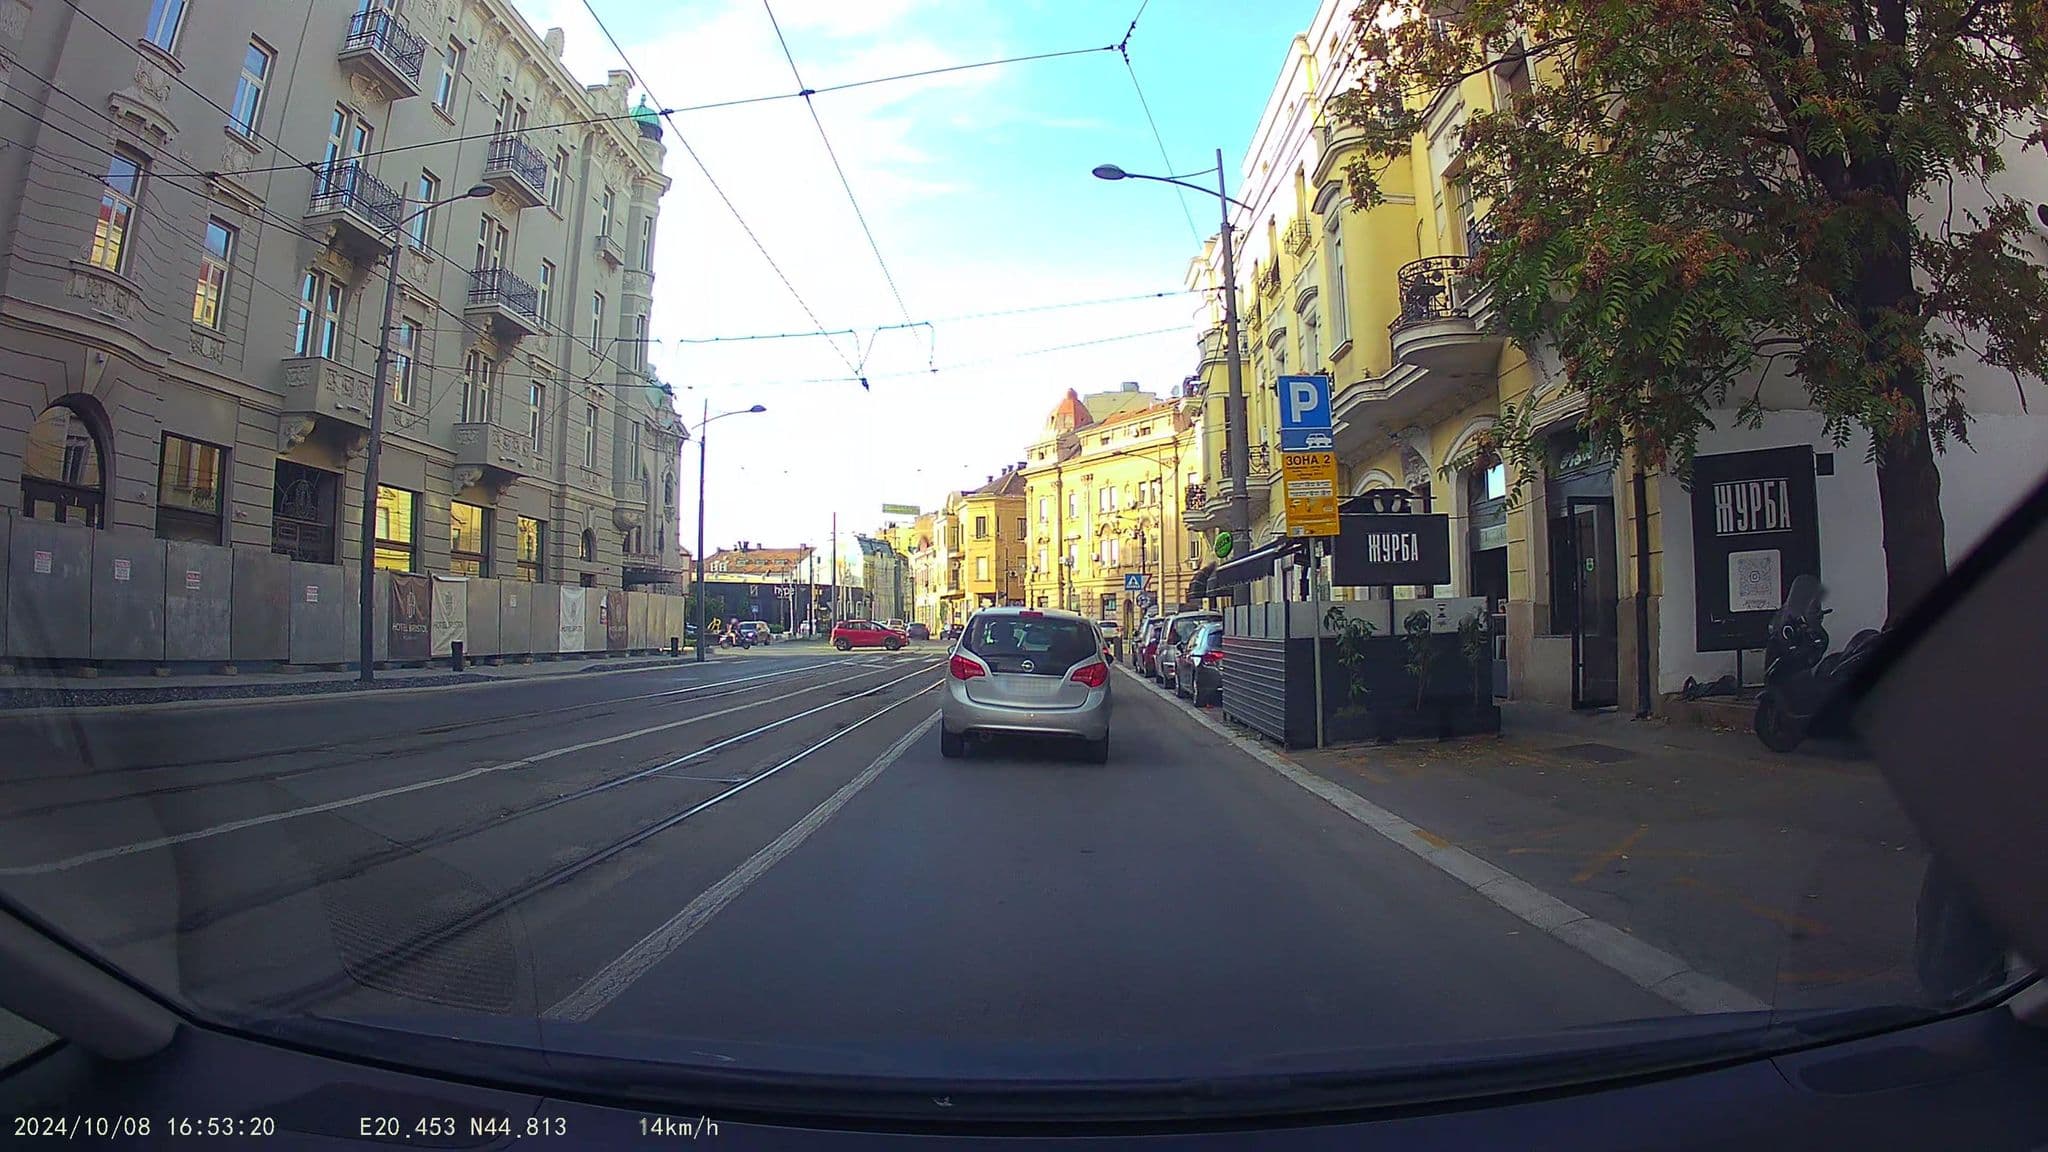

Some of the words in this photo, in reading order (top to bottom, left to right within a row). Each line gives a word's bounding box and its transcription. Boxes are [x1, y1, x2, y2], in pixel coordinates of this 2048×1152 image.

[1289, 381, 1319, 423] P
[1286, 455, 1319, 466] ЗОНА
[1323, 454, 1331, 464] 2
[1714, 480, 1791, 533] ЖУРБА
[1367, 533, 1419, 563] ЖУРБА
